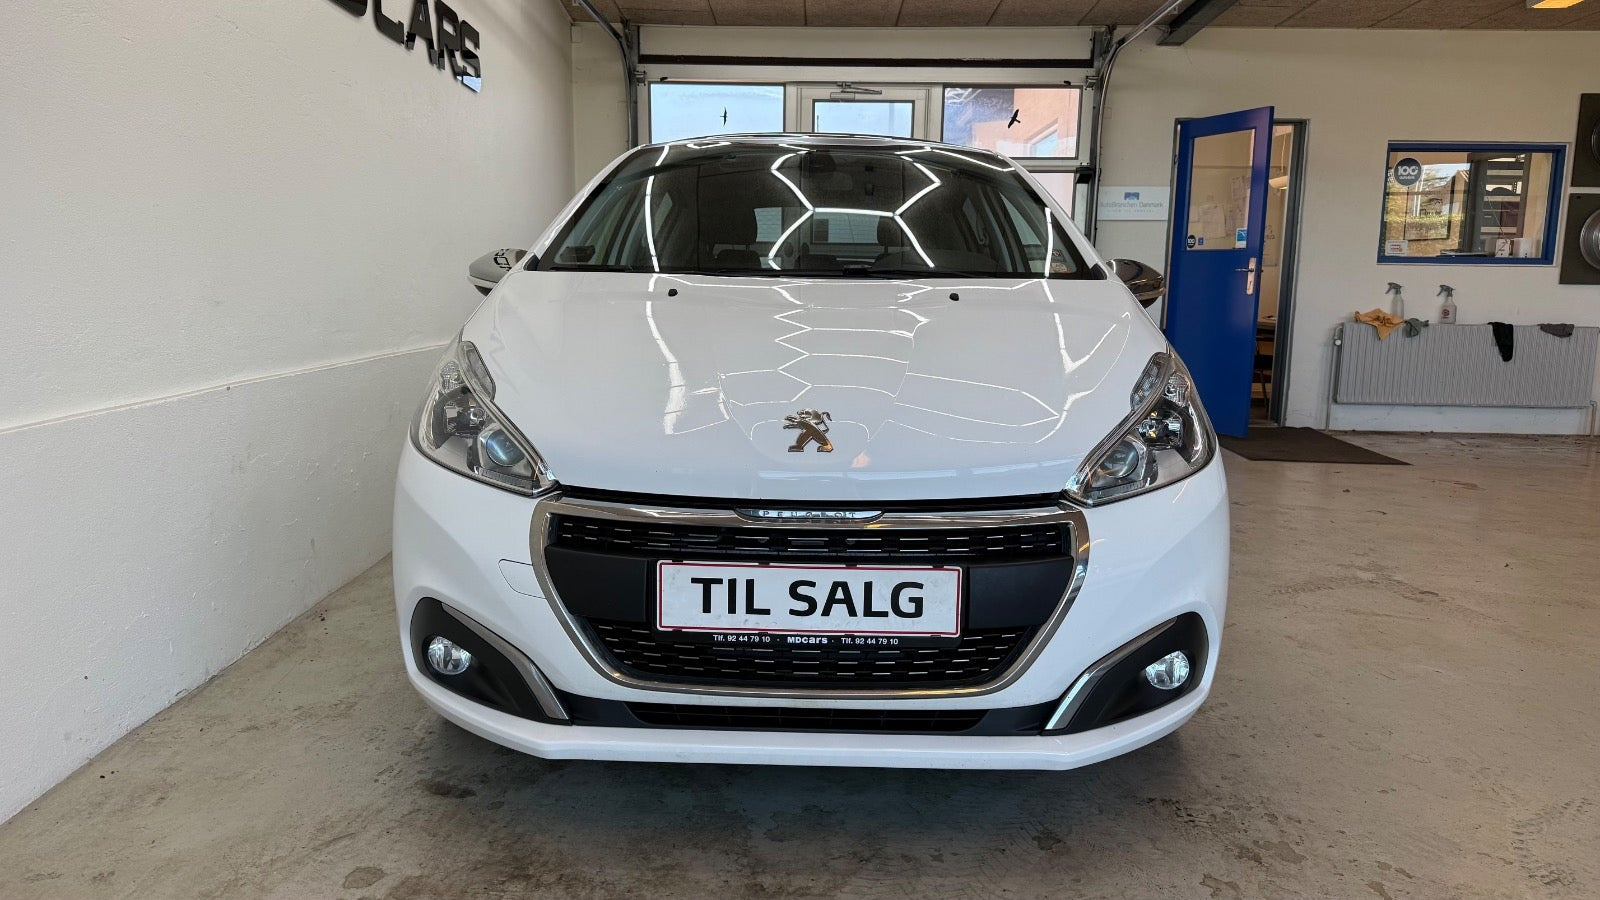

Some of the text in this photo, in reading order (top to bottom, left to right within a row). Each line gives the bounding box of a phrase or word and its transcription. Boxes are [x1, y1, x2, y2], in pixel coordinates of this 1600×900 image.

[328, 0, 482, 93] CARS
[690, 577, 925, 619] TIL SALG
[712, 634, 725, 642] Tlf.
[750, 635, 760, 643] 79
[761, 635, 771, 643] 10
[841, 637, 853, 645] Tlf.
